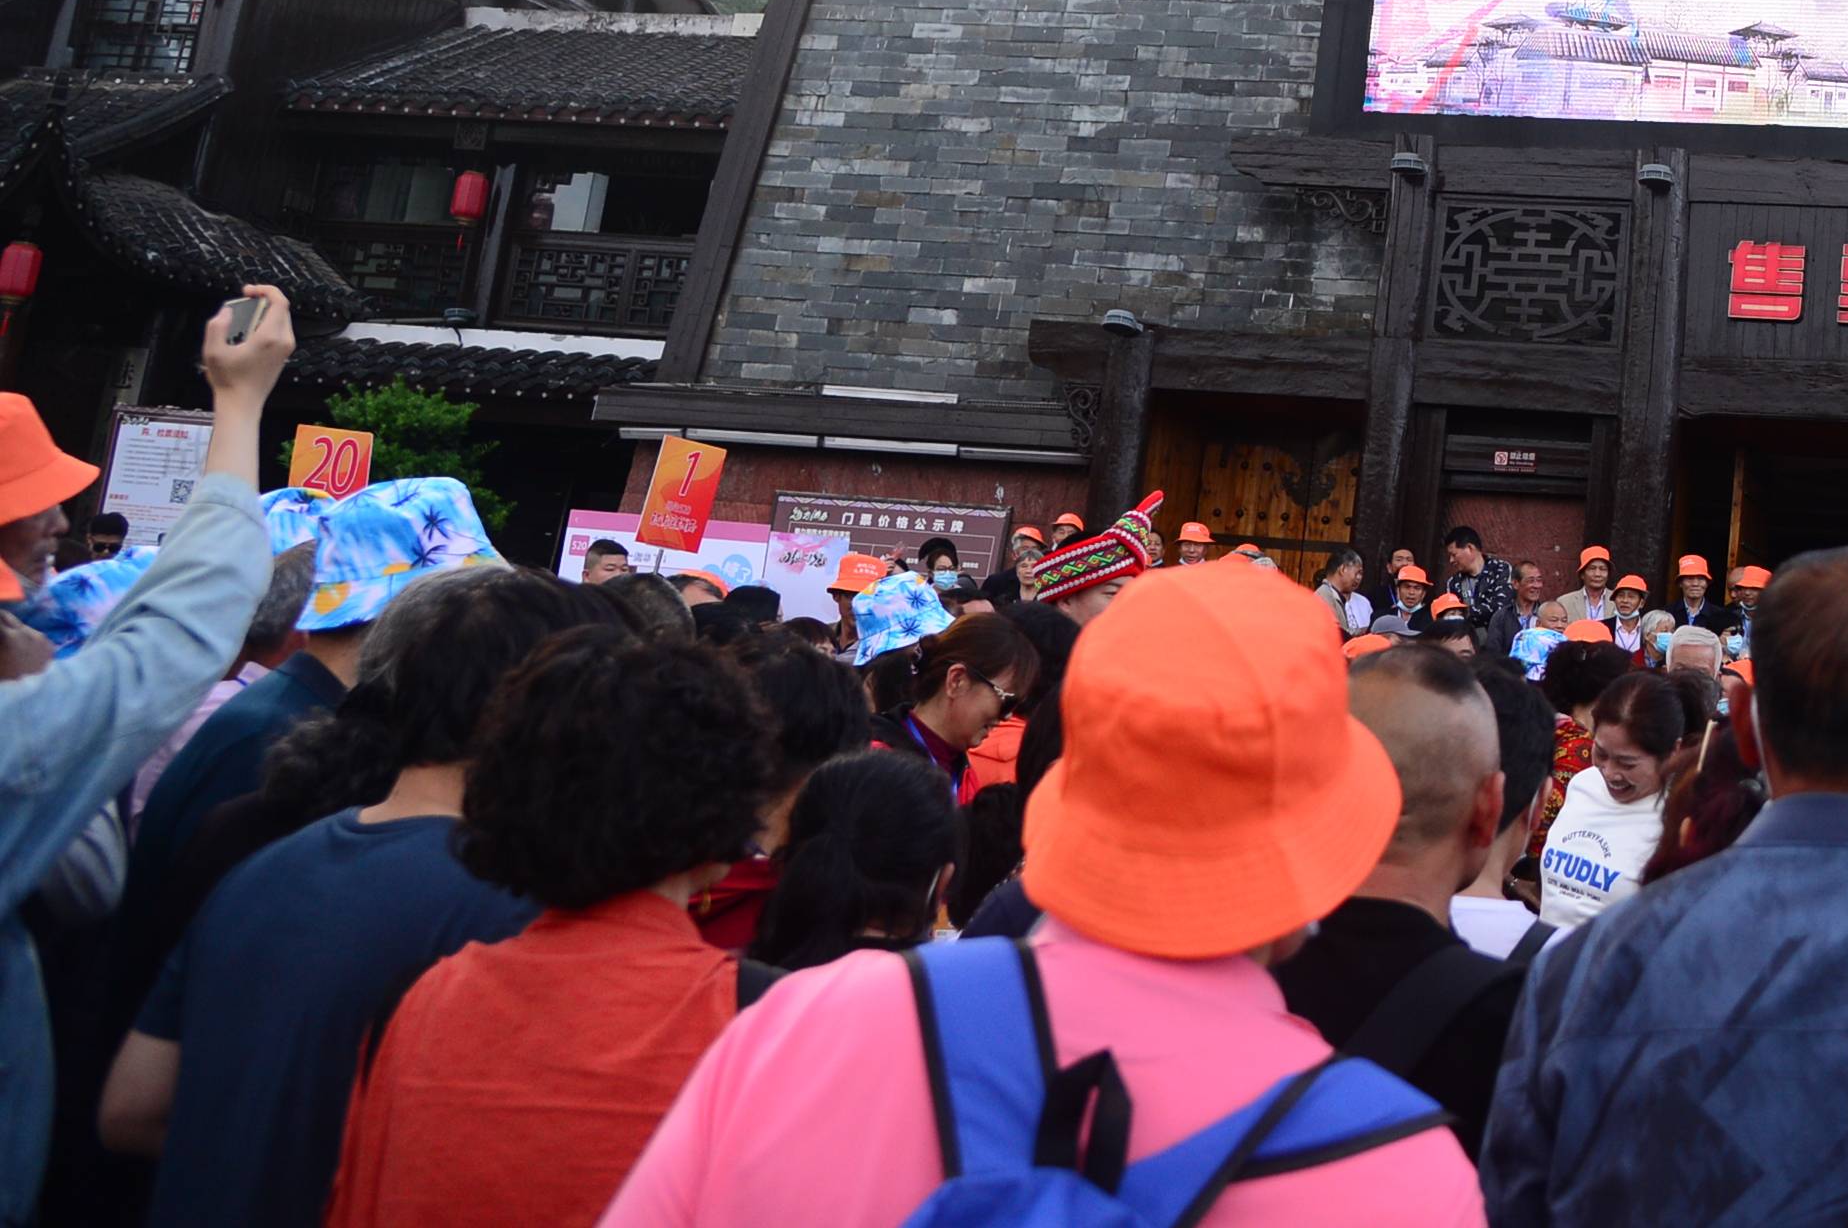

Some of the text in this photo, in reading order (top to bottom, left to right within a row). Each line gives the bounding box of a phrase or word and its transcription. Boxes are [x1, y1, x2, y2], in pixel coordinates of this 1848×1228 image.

[302, 435, 360, 495] 20
[678, 450, 702, 497] 1
[841, 511, 965, 534] 门票价格公示牌
[1543, 847, 1621, 893] STUDLY
